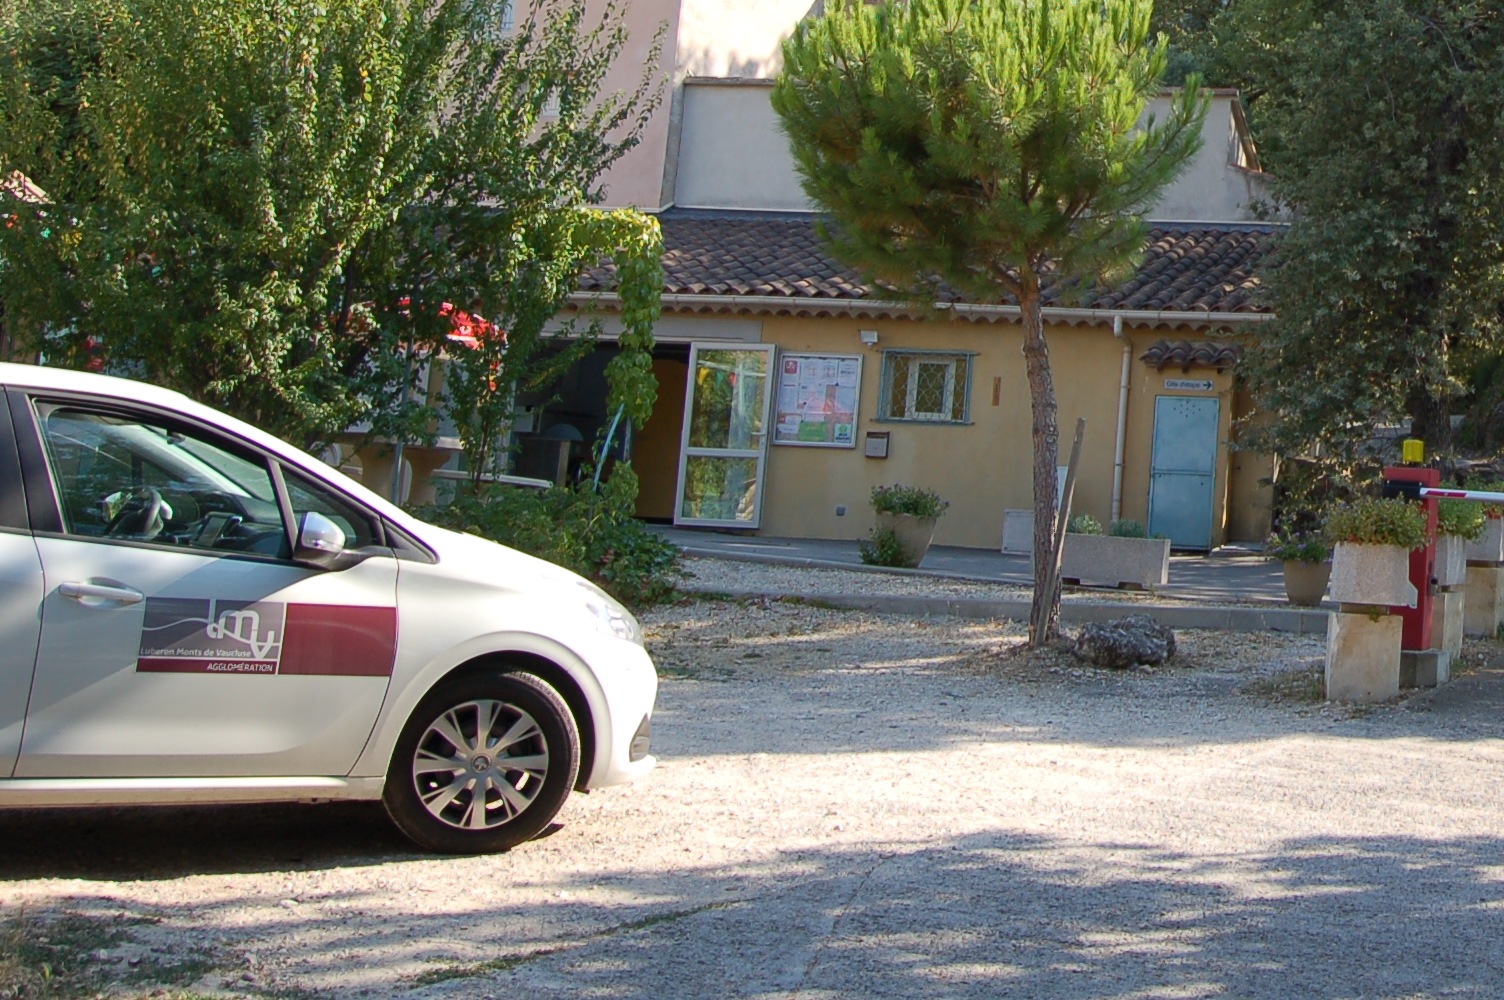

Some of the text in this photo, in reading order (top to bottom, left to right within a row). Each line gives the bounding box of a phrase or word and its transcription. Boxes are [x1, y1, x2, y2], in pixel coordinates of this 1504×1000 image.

[140, 647, 252, 658] Luberon Monts de Vaucluse
[206, 662, 273, 672] AGGLOMÉRATION
